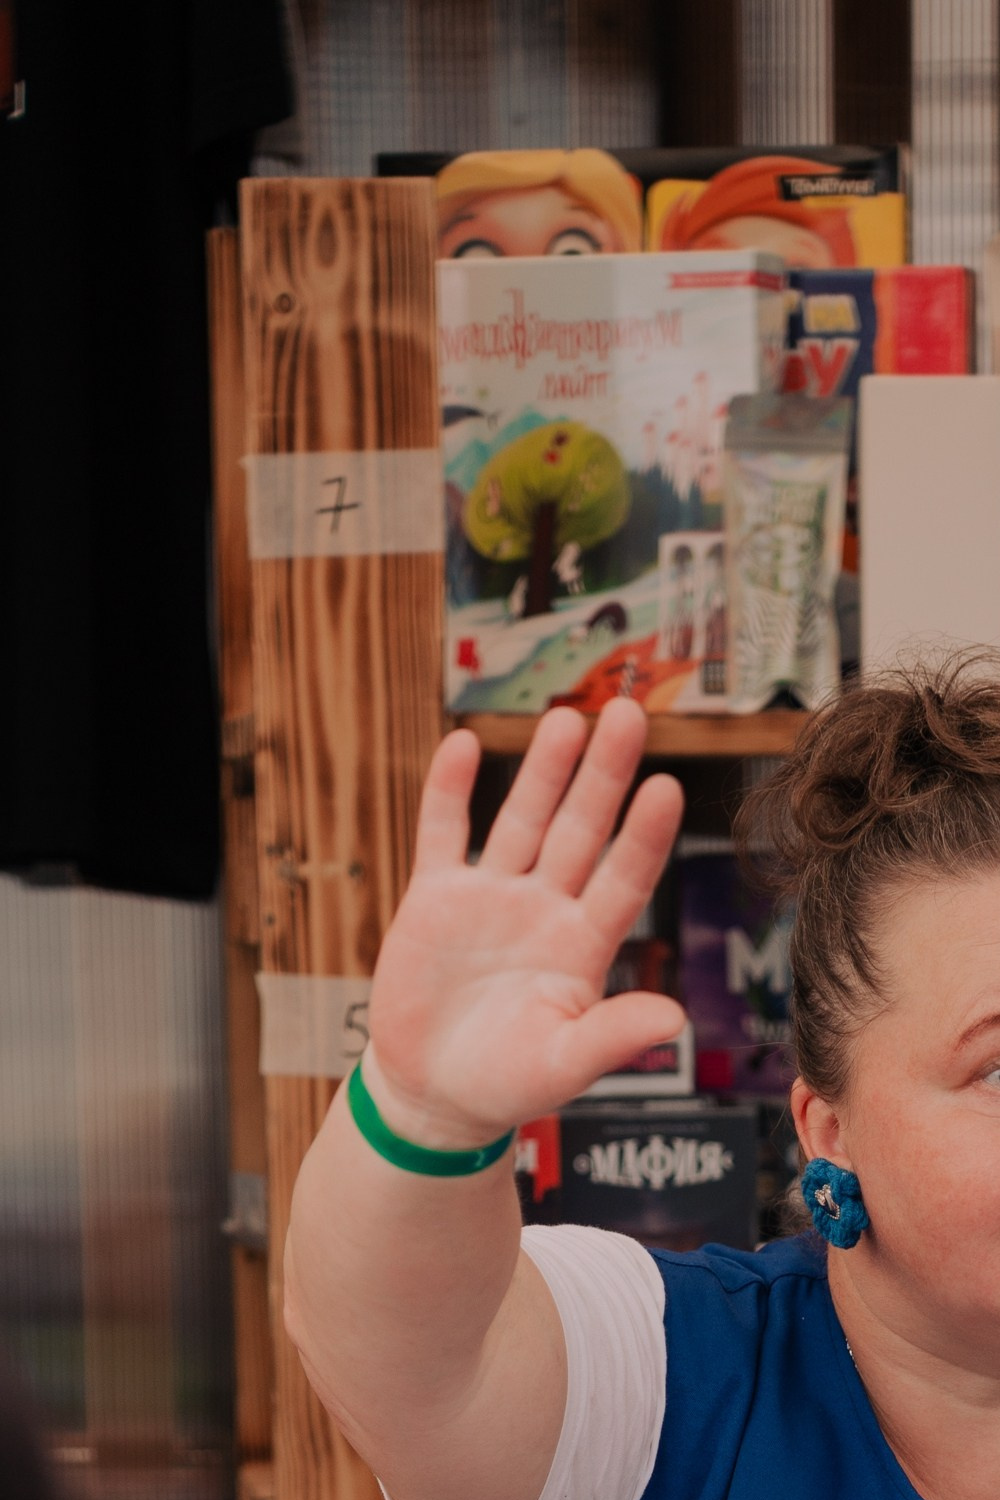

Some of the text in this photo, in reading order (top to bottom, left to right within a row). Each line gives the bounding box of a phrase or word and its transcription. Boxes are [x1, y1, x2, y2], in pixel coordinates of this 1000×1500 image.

[315, 476, 363, 535] 7
[342, 1001, 370, 1058] 5
[589, 1134, 725, 1191] МАФИЯ
